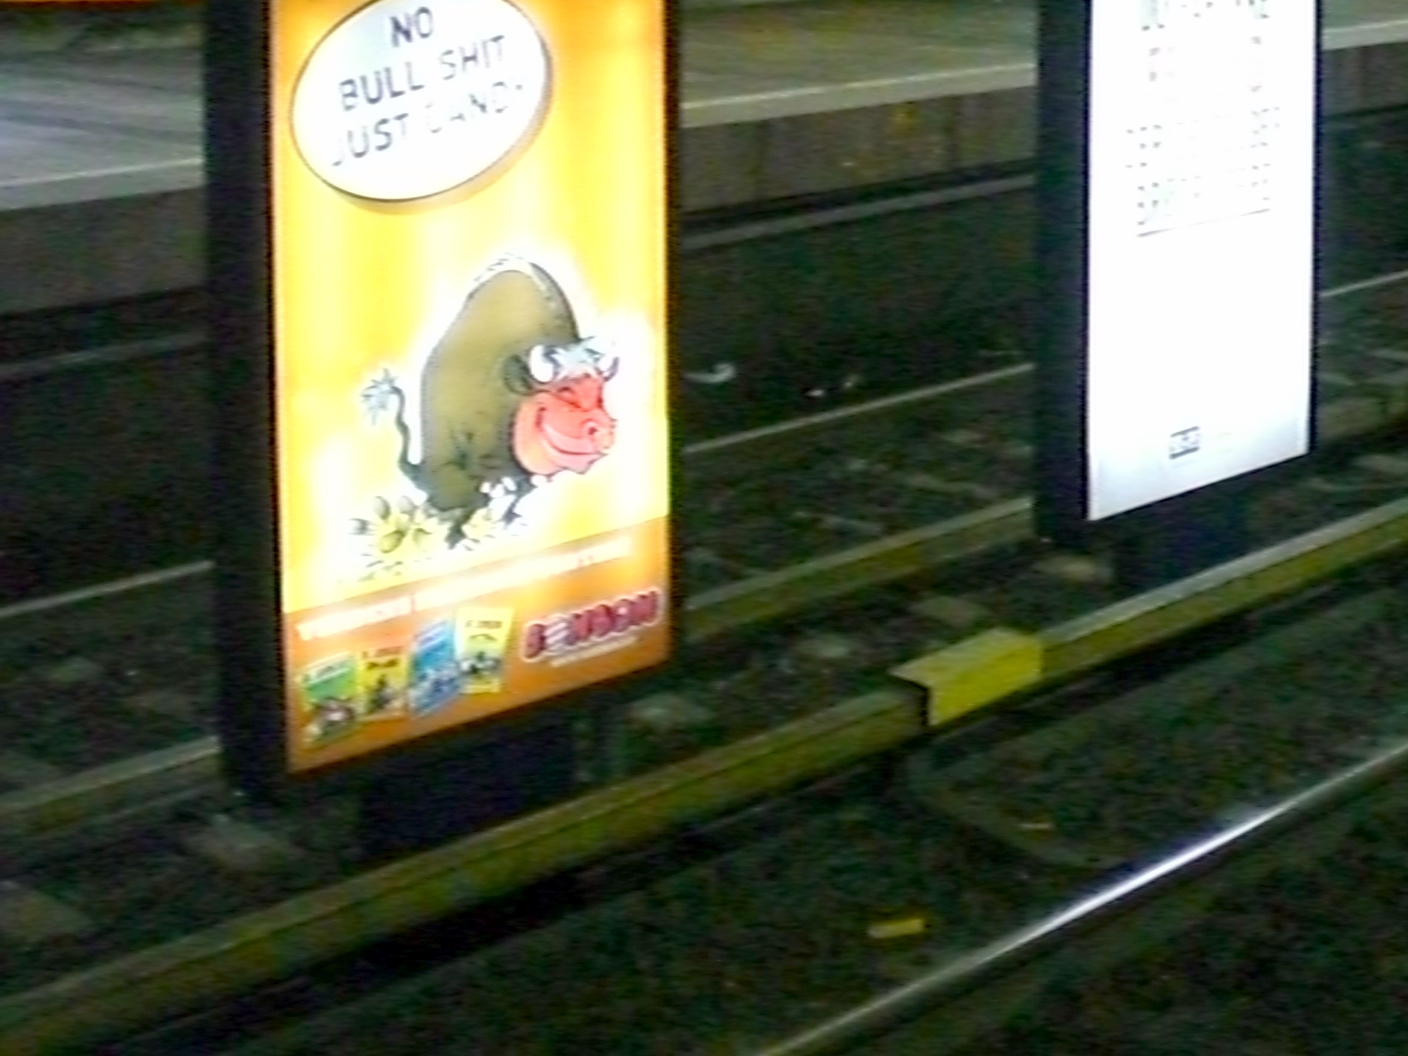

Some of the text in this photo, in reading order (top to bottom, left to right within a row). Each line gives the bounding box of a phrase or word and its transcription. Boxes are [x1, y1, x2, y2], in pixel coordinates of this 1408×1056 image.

[389, 5, 434, 48] NO
[338, 34, 506, 112] BULL SHIT
[331, 76, 527, 167] JUST CAND
